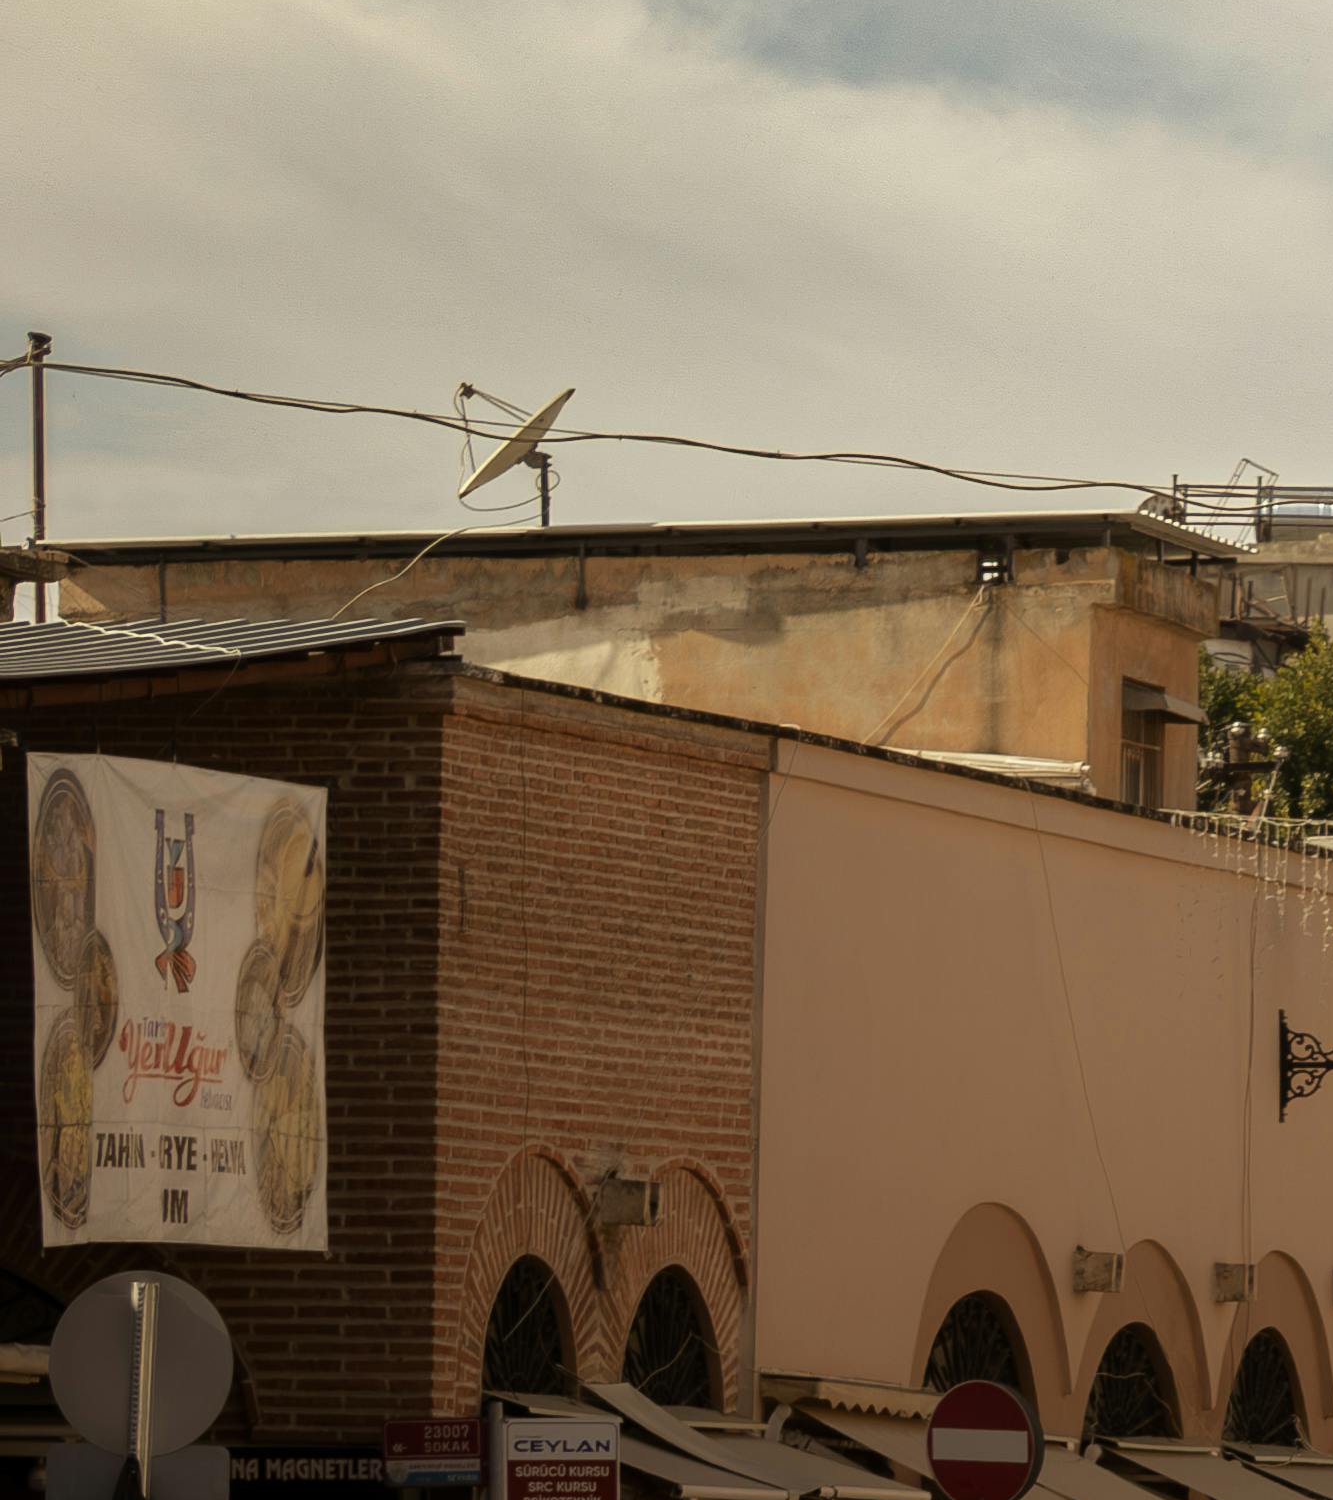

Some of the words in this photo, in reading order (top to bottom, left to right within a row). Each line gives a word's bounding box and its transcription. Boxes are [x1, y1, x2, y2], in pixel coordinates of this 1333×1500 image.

[423, 1441, 470, 1453] SOKAK
[513, 1440, 610, 1452] CEYLAN
[515, 1463, 566, 1477] SÜRÜCÜ
[569, 1466, 610, 1477] KURSU
[528, 1481, 553, 1492] SRC
[556, 1481, 597, 1493] KURSU
